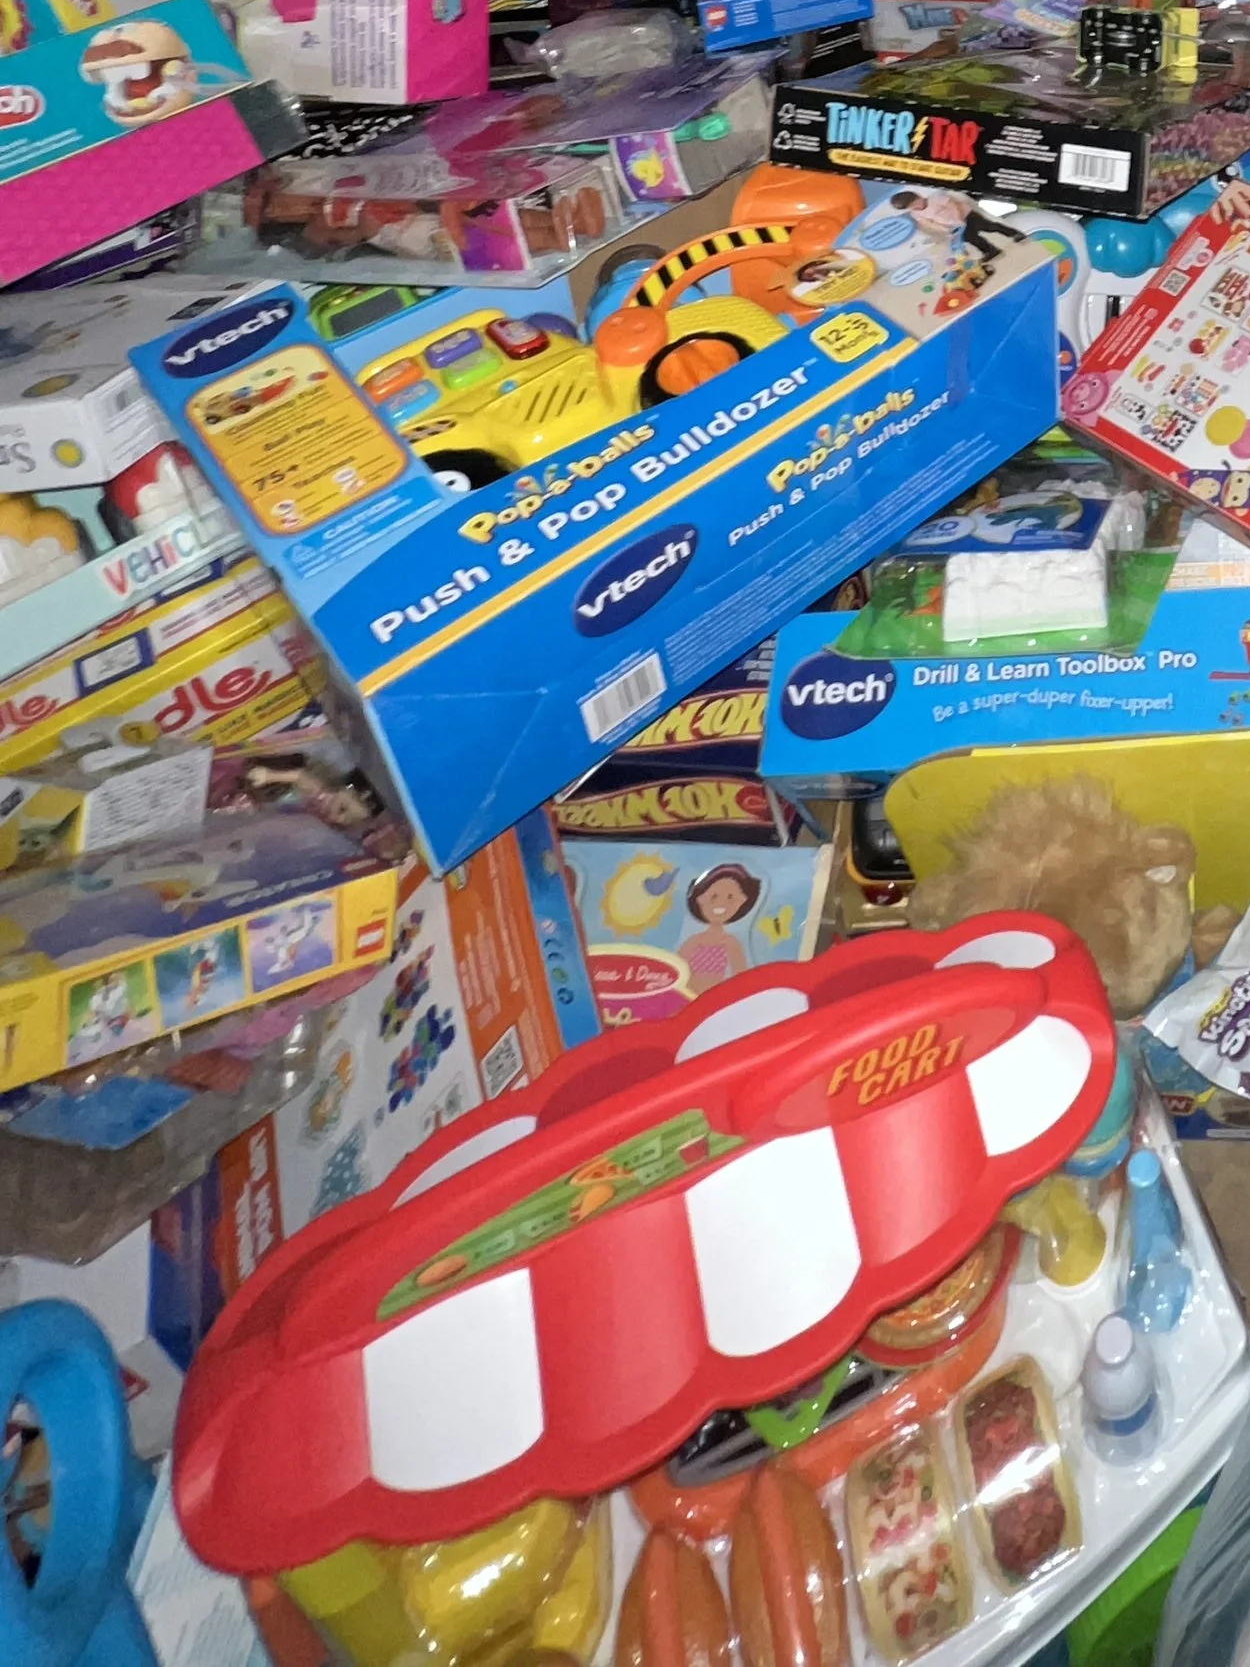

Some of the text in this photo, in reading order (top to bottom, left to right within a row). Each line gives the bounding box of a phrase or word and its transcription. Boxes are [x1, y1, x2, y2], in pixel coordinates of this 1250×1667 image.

[928, 115, 982, 165] TAR
[163, 306, 290, 367] vtech
[252, 464, 299, 492] 75+
[728, 500, 785, 547] Push
[788, 484, 807, 506] &
[856, 389, 951, 465] Bulldozer
[369, 564, 491, 644] Push
[498, 538, 536, 566] &
[630, 364, 809, 483] Bulldozer
[577, 538, 691, 620] vtech
[787, 674, 888, 708] vtech
[912, 649, 1198, 687] Drill & Learn Toolbox Pro
[933, 702, 955, 723] Be
[972, 688, 1077, 712] super-duper
[1079, 690, 1175, 717] fixer-upper!
[827, 1023, 938, 1097] FOOD
[858, 1034, 965, 1107] CART
